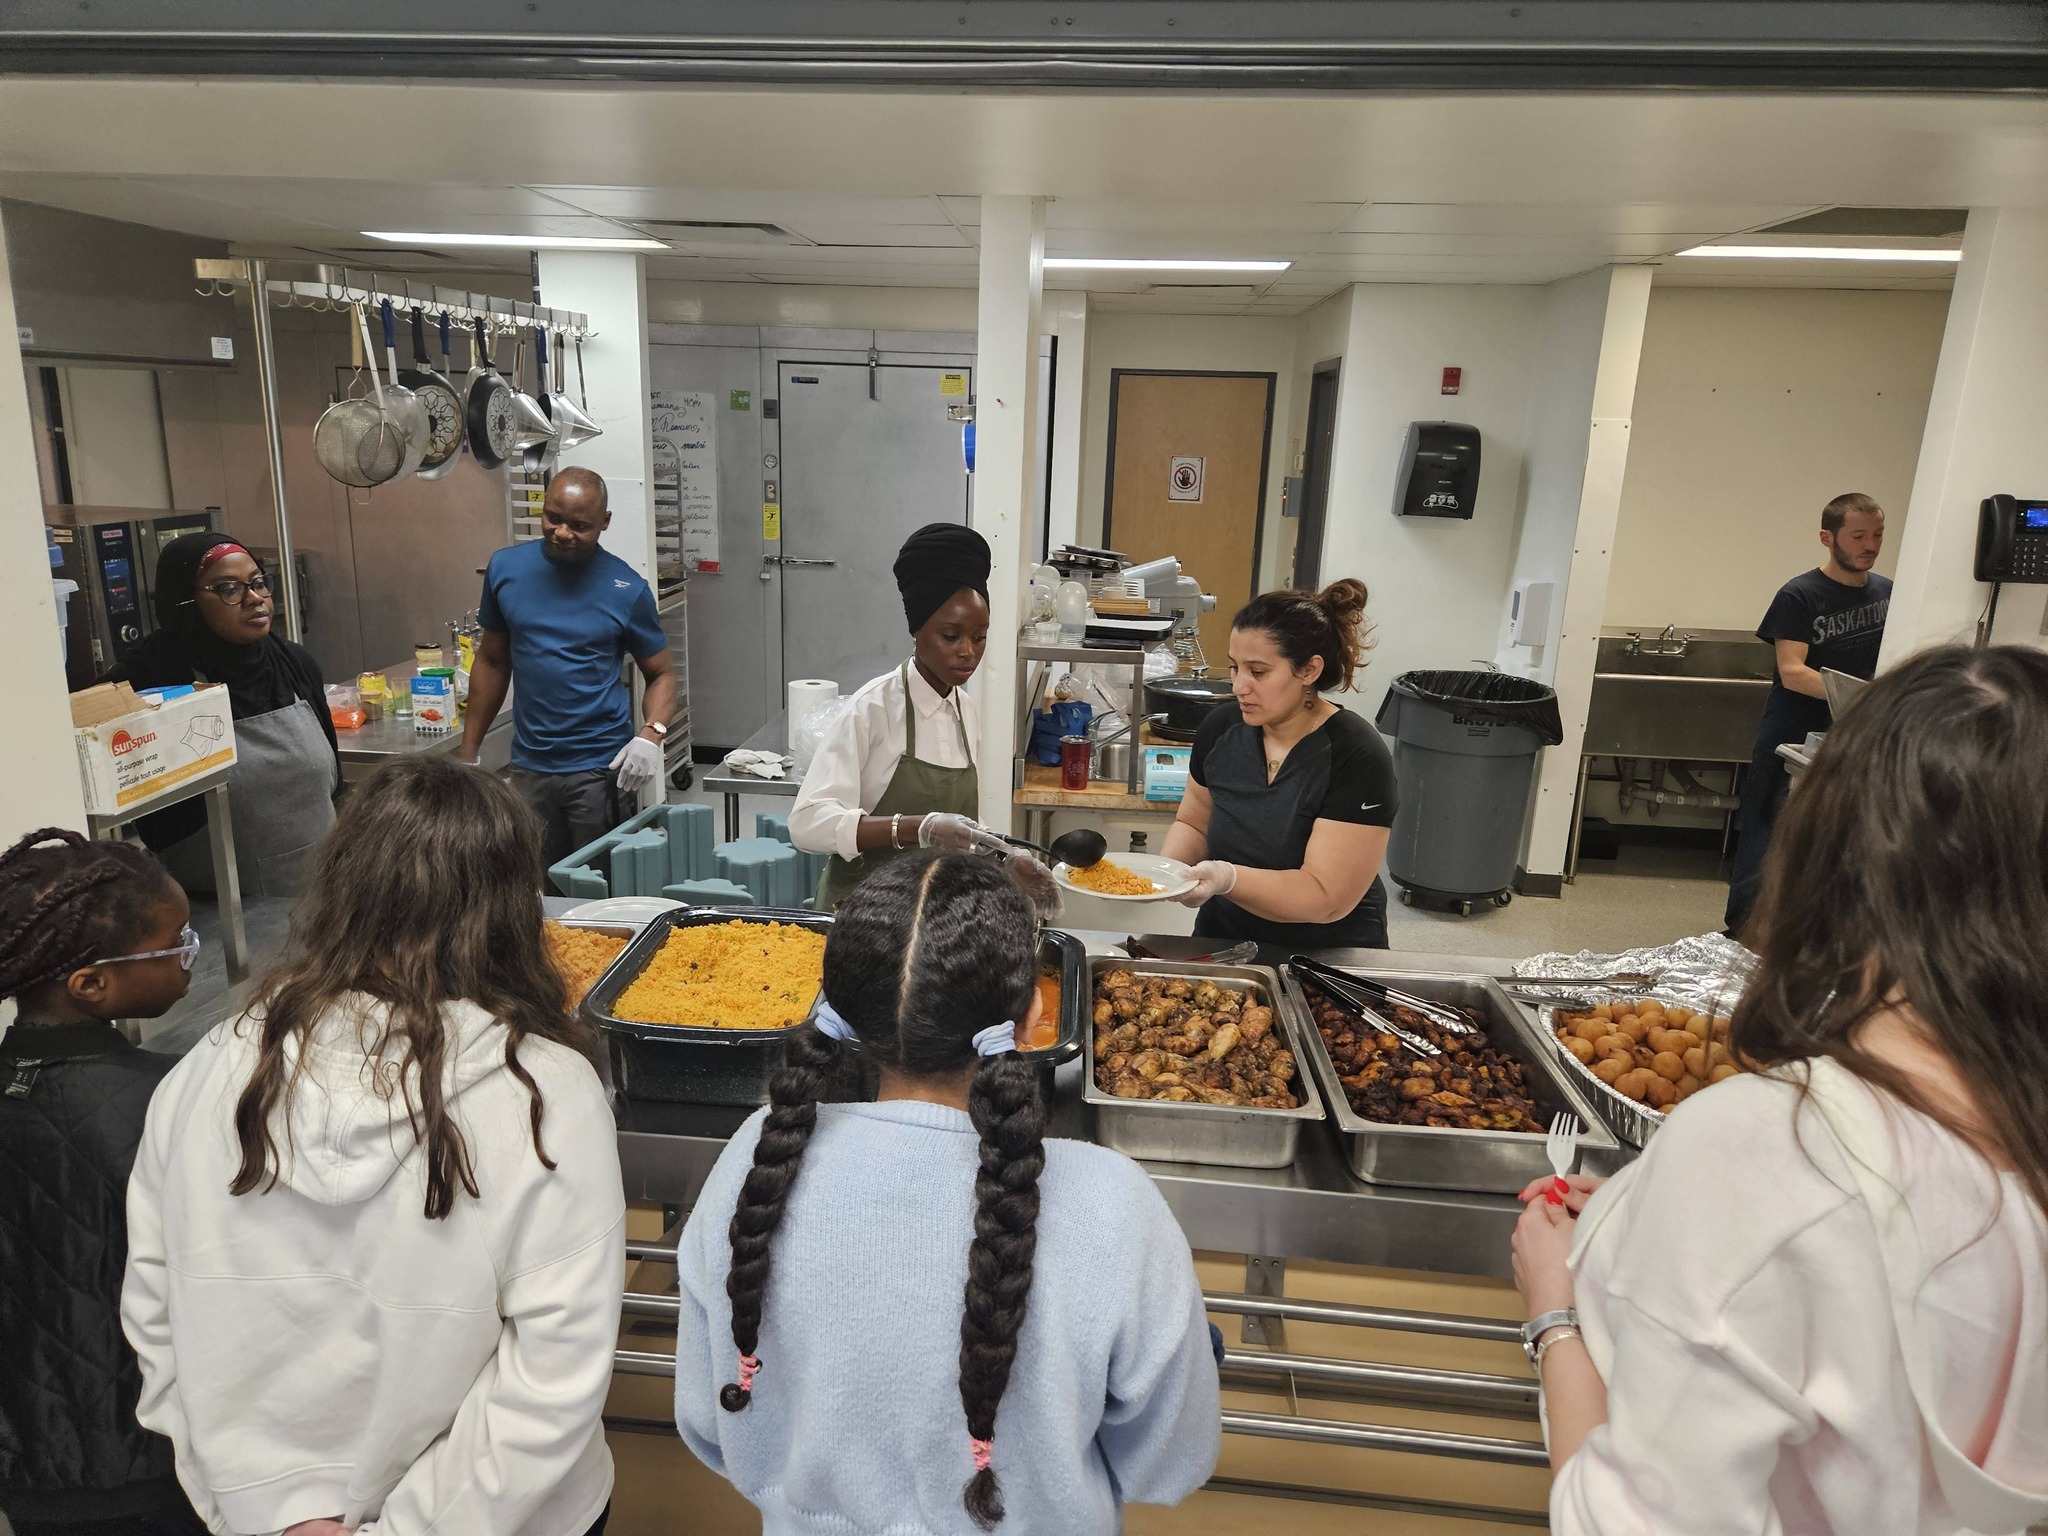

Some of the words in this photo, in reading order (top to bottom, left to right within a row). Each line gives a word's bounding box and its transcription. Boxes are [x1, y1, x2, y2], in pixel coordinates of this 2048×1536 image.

[1812, 599, 1890, 644] SASKATOO
[114, 732, 156, 754] sunspun
[145, 753, 158, 762] wrap
[140, 771, 151, 779] tout
[152, 766, 166, 775] usage
